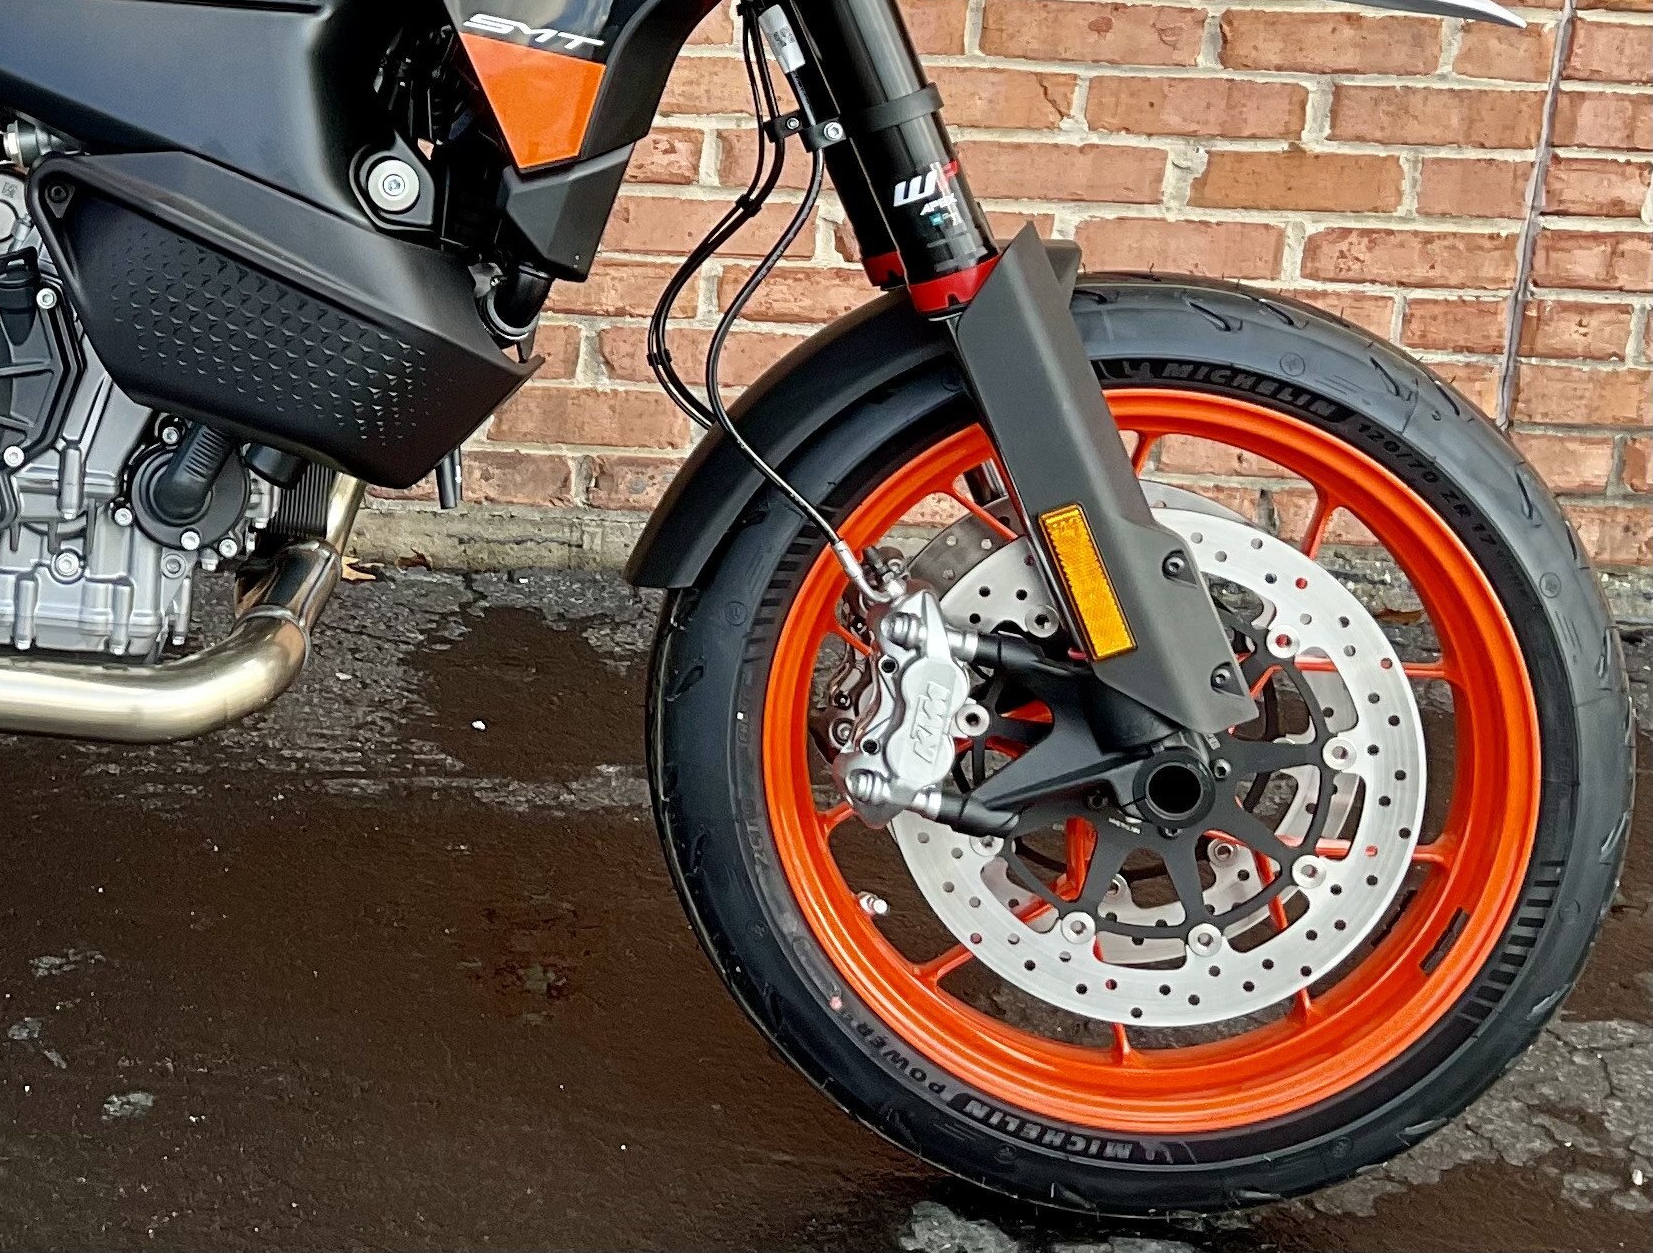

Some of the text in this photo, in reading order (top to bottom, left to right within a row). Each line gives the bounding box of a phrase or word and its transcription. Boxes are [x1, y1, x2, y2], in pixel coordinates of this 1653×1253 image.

[463, 13, 605, 50] SMT
[1160, 362, 1496, 546] MICHELIN 120/70 ZR 17
[910, 680, 950, 764] KTM
[856, 1021, 1133, 1160] MICHELIN POWER
